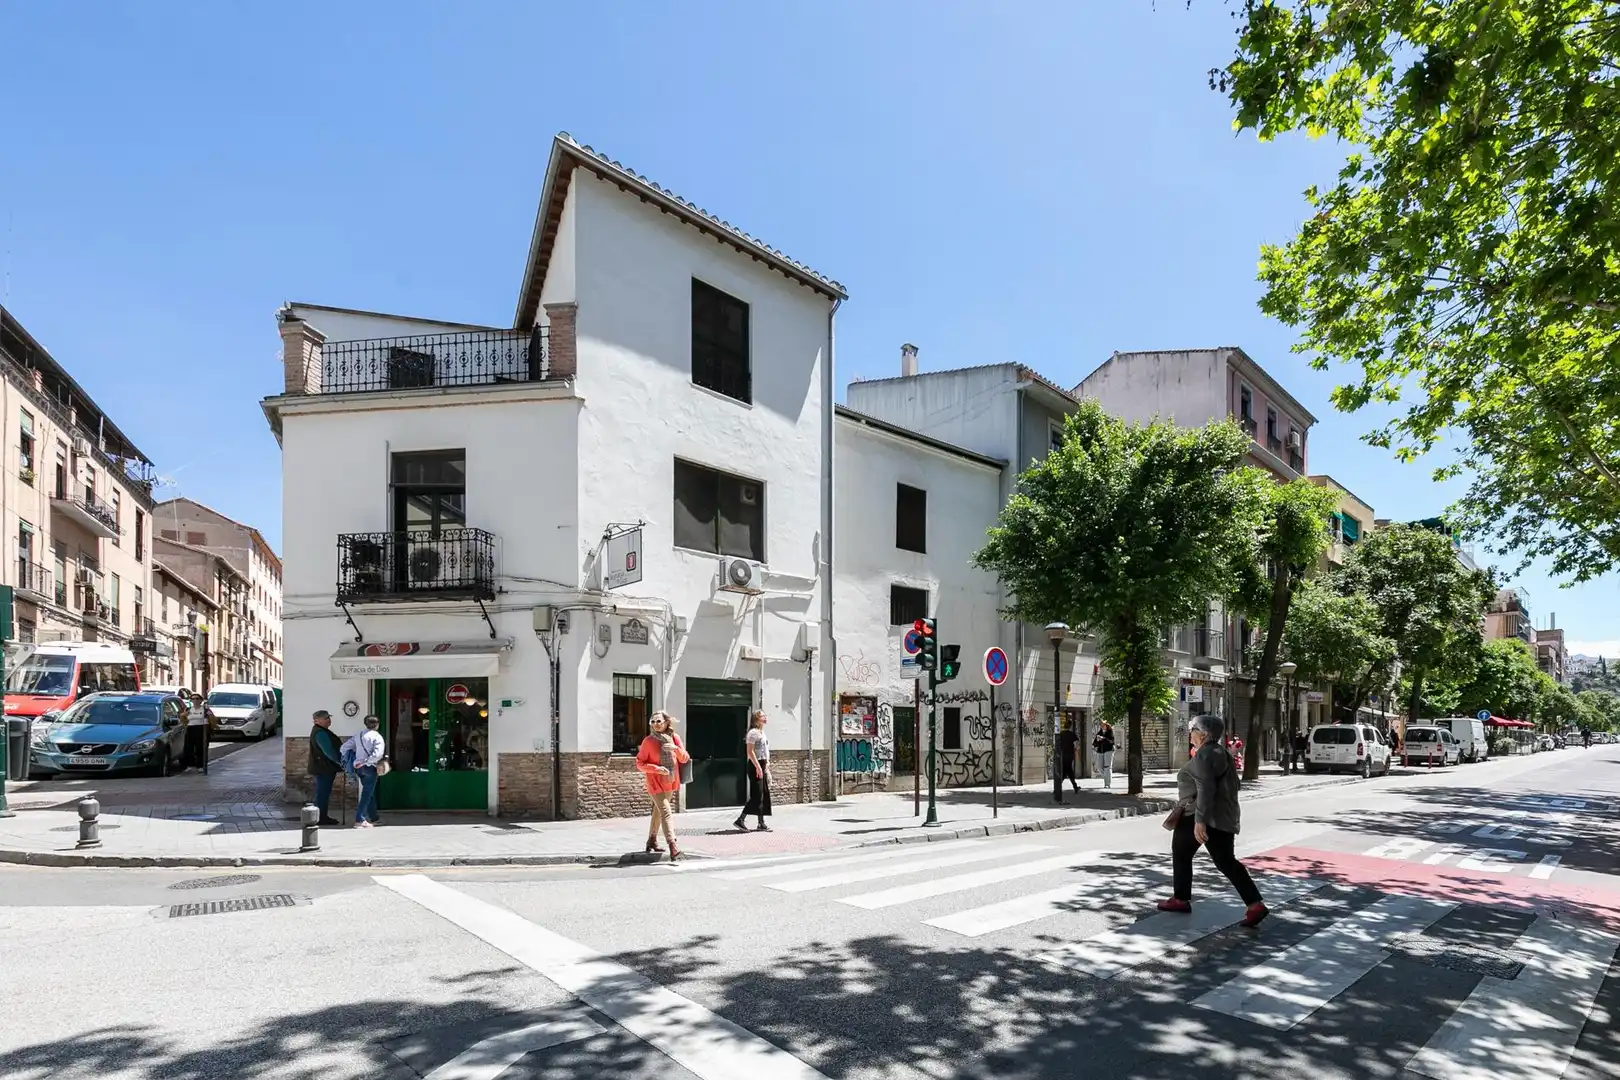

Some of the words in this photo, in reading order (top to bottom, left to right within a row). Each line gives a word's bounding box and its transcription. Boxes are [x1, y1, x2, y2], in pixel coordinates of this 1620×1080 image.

[347, 666, 366, 676] gracia
[367, 665, 376, 673] de
[1361, 836, 1562, 880] BICI
